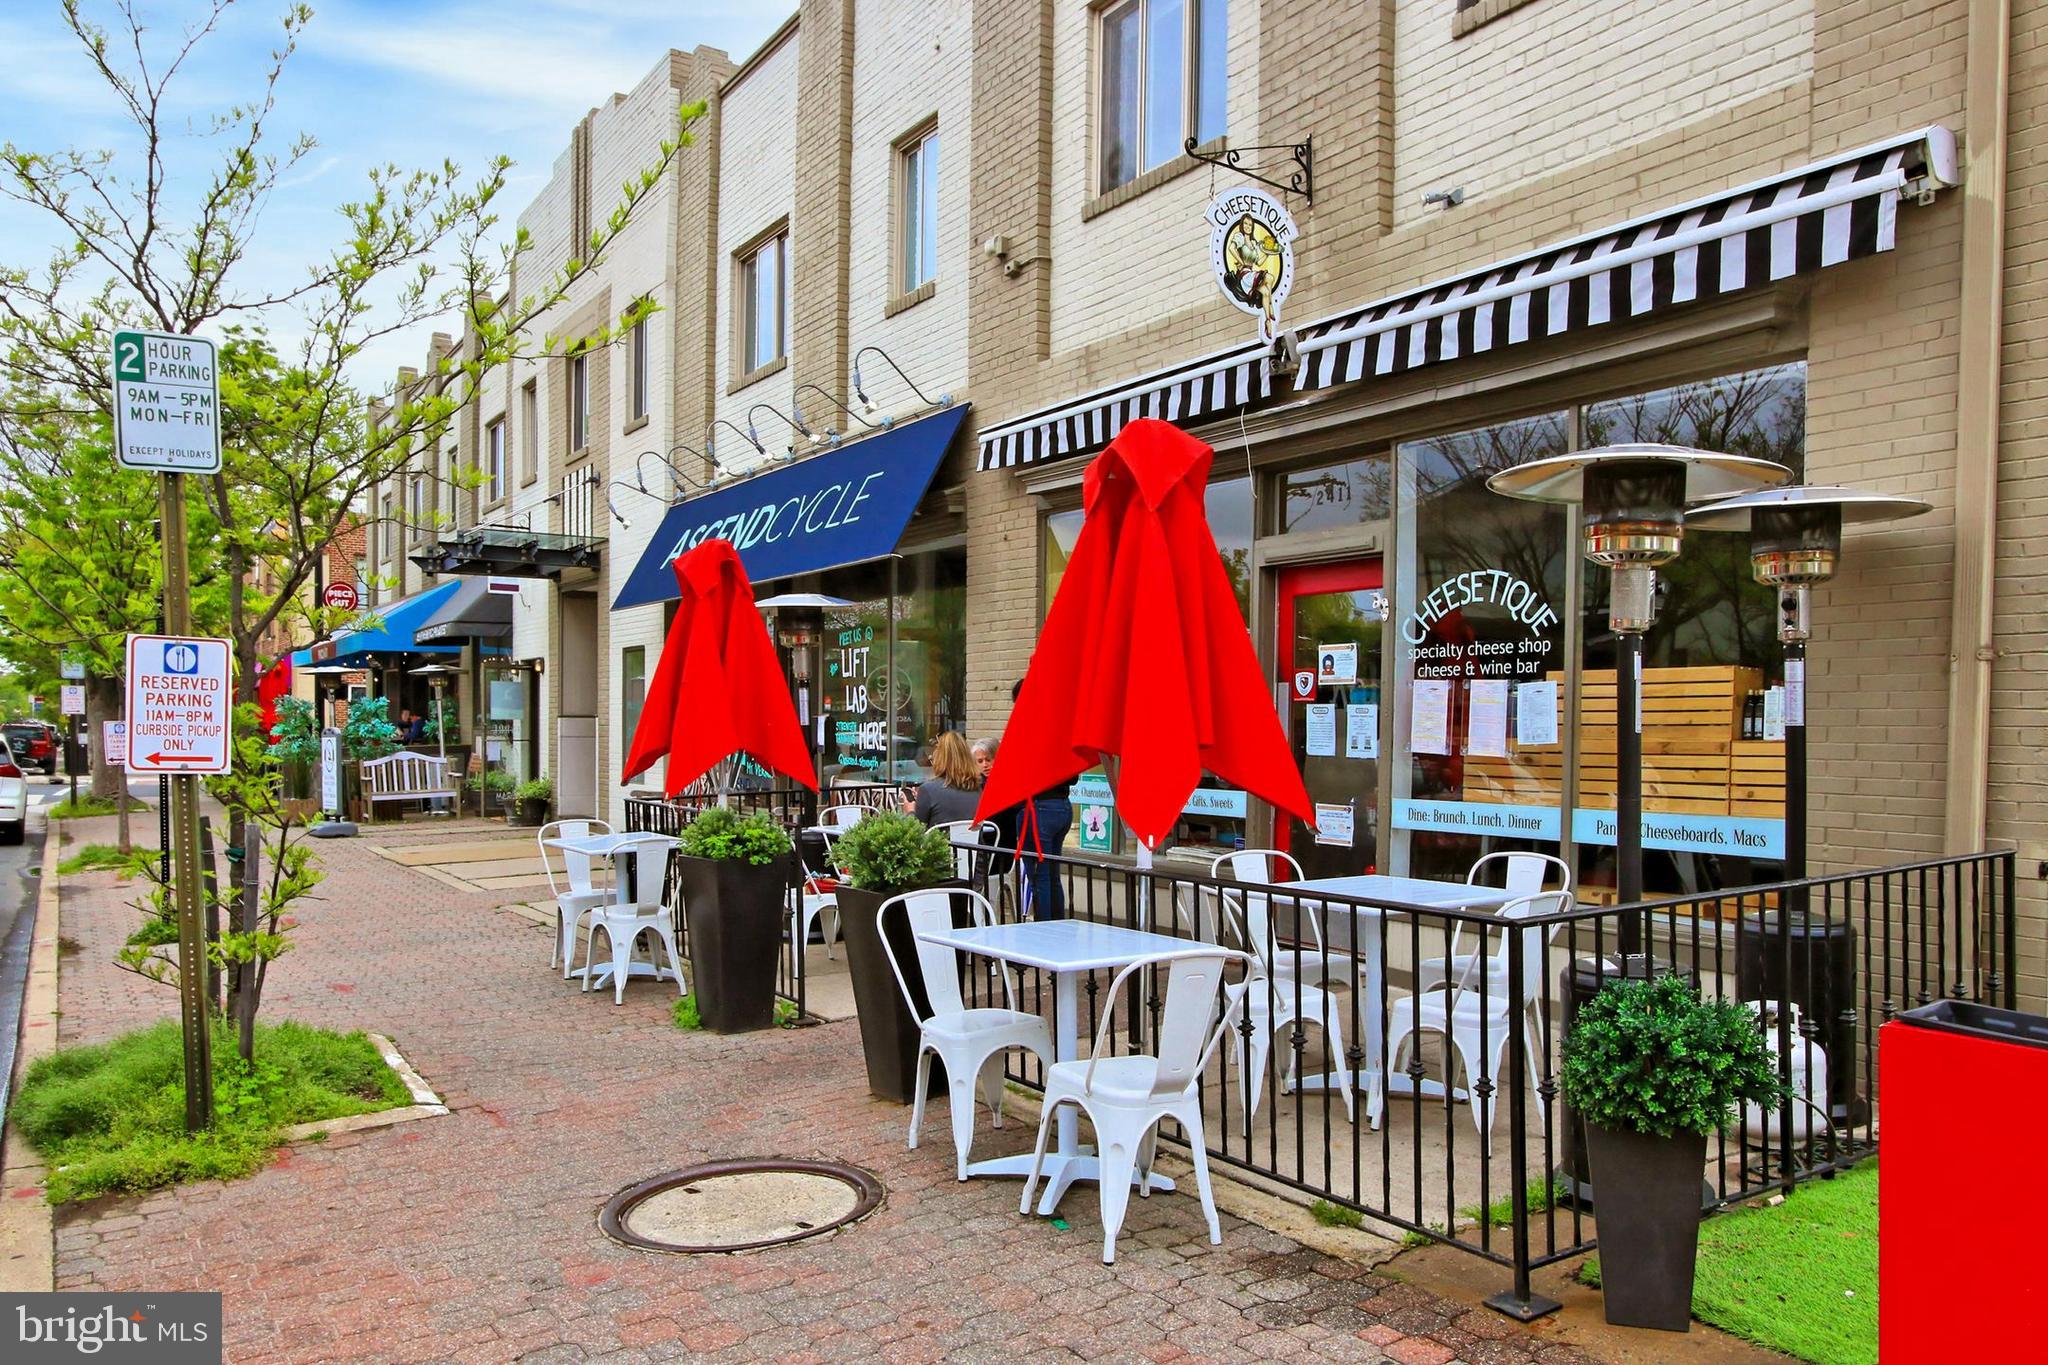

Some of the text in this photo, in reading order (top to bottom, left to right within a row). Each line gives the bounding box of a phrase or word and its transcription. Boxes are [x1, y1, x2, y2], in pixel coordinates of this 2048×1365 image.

[1214, 195, 1291, 239] CHEESETIQUE
[120, 342, 192, 374] 2 HOUR
[149, 361, 210, 381] PARKING
[129, 445, 213, 460] EXCEPT HOLIDAYS
[1316, 485, 1352, 506] 2411
[328, 589, 353, 598] PIECE
[1402, 568, 1559, 645] CHEESETIQUE
[853, 628, 862, 643] US
[1408, 637, 1551, 662] specialty cheese shop
[841, 647, 870, 678] LIFT
[1417, 658, 1540, 678] cheese & wine bar
[141, 675, 219, 691] RESERVED
[145, 692, 212, 708] PARKING
[845, 685, 868, 714] LAB
[136, 723, 221, 737] CURBSIDE PICKUP
[859, 721, 887, 751] HERE
[163, 738, 194, 751] ONLY
[1210, 795, 1234, 809] Sweets
[1408, 807, 1431, 822] Dine:
[1508, 814, 1542, 830] Dinner
[1733, 829, 1767, 847] Macs
